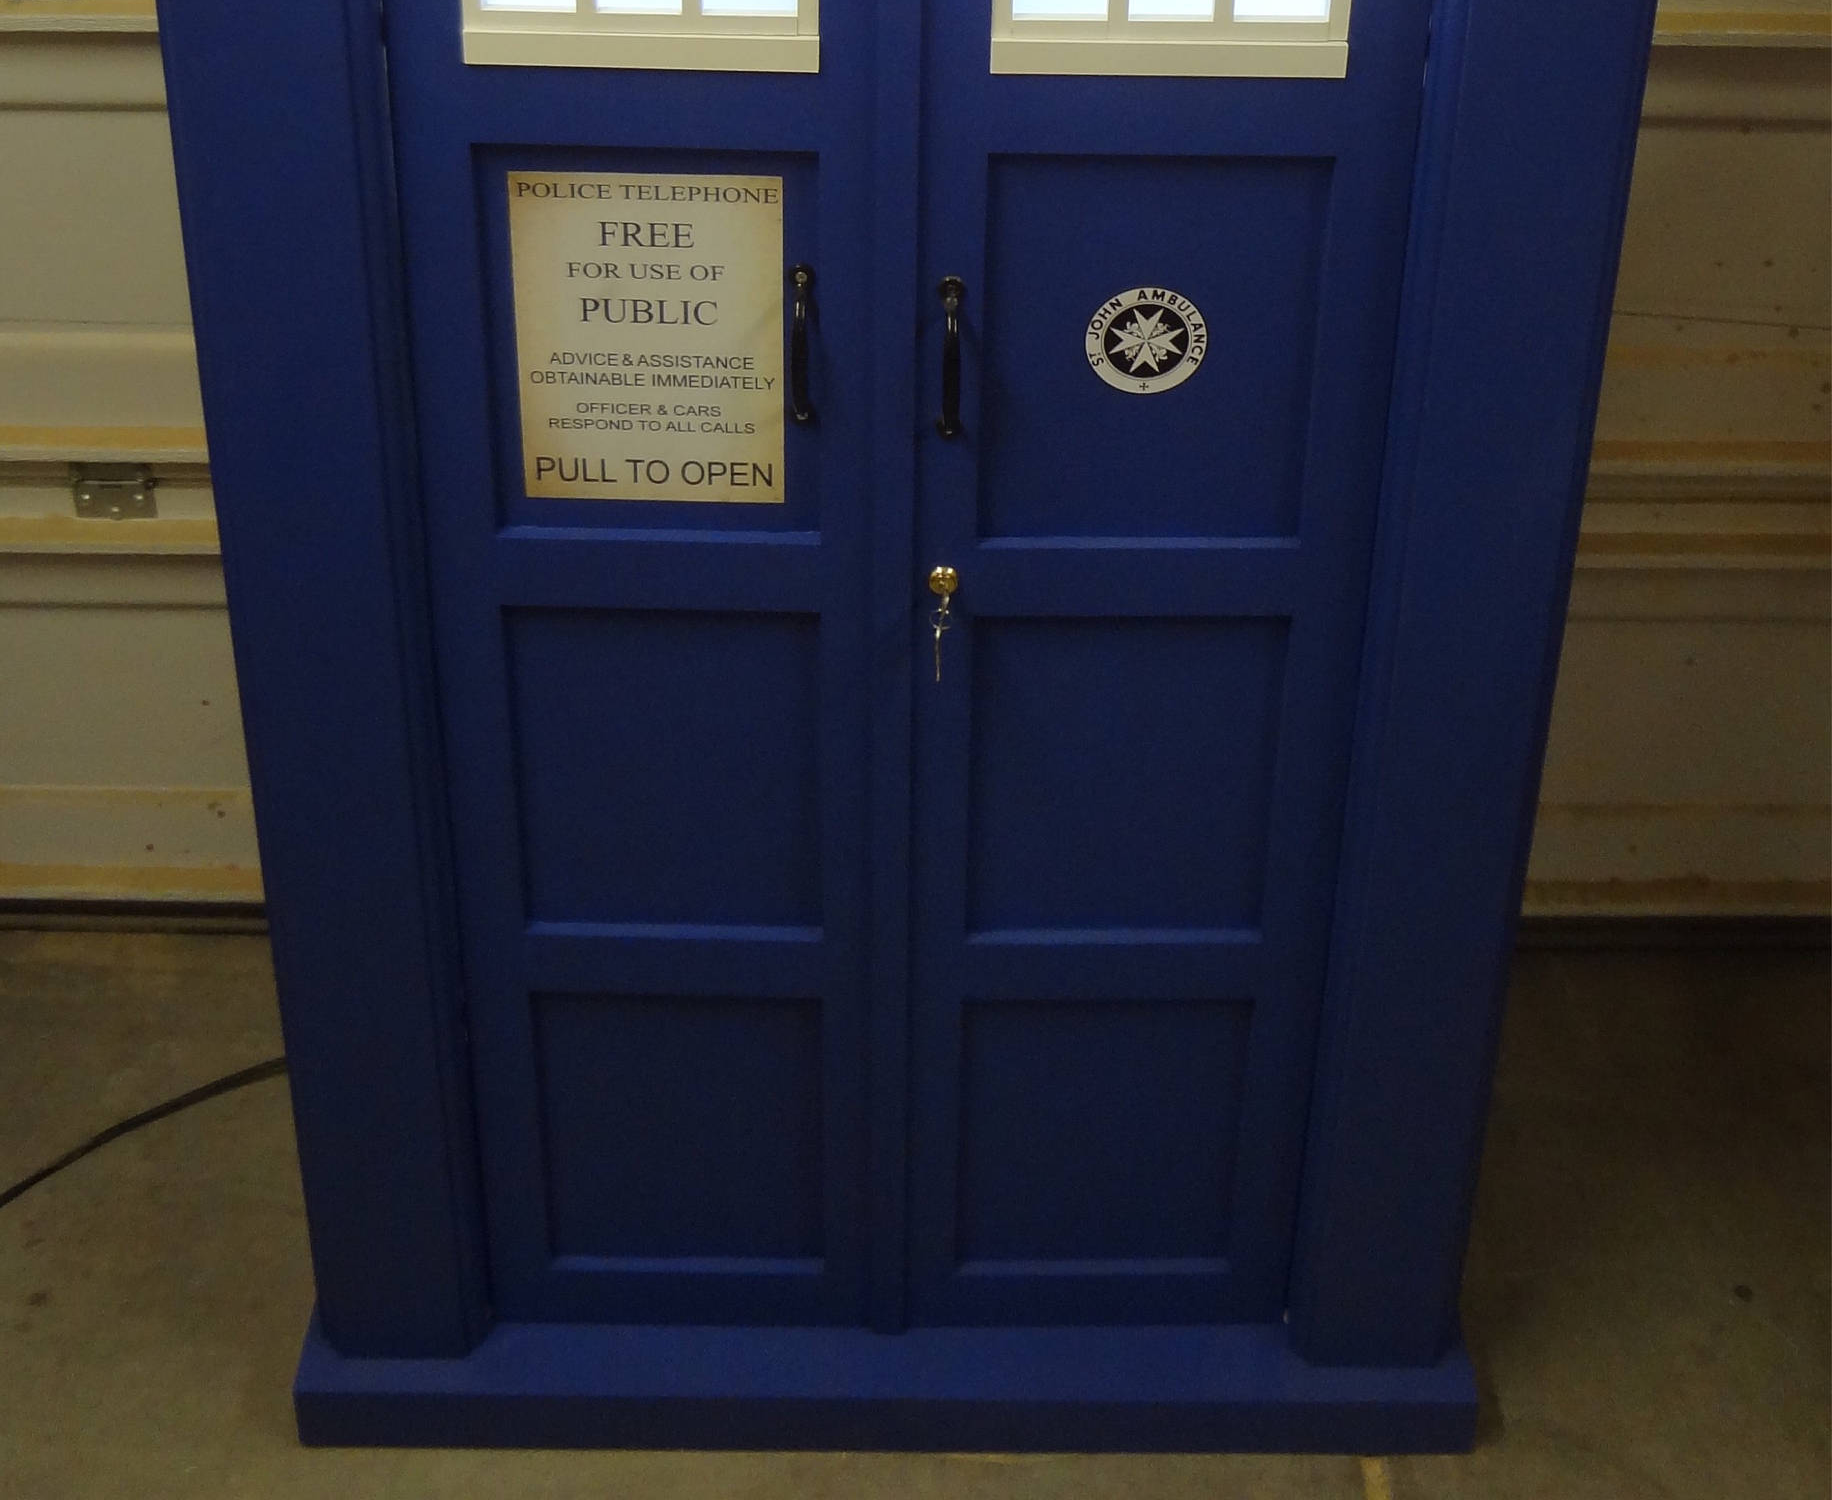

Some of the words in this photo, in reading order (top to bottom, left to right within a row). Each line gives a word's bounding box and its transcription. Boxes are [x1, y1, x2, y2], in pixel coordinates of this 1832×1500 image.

[516, 182, 611, 199] POLICE
[619, 184, 779, 204] TELEPHONE
[598, 221, 695, 249] FREE
[567, 262, 621, 279] FOR
[630, 264, 682, 280] USE
[690, 265, 725, 281] OF
[580, 298, 718, 326] PUBLIC
[1088, 298, 1123, 340] JOHN
[1137, 289, 1206, 366] AMBULANCE
[550, 352, 618, 366] ADVICE
[622, 353, 634, 367] &
[637, 354, 754, 370] ASSISTANCE
[530, 371, 646, 387] OBTAINABLE
[652, 374, 775, 390] IMMEDIATELY
[576, 402, 651, 415] OFFICER
[658, 404, 667, 416] &
[673, 404, 722, 417] CARS
[549, 418, 634, 431] RESPOND
[638, 420, 662, 432] TO
[666, 421, 696, 432] ALL
[700, 421, 755, 434] CALLS
[535, 456, 617, 483] PULL
[625, 459, 670, 484] TO
[681, 461, 773, 487] OPEN
